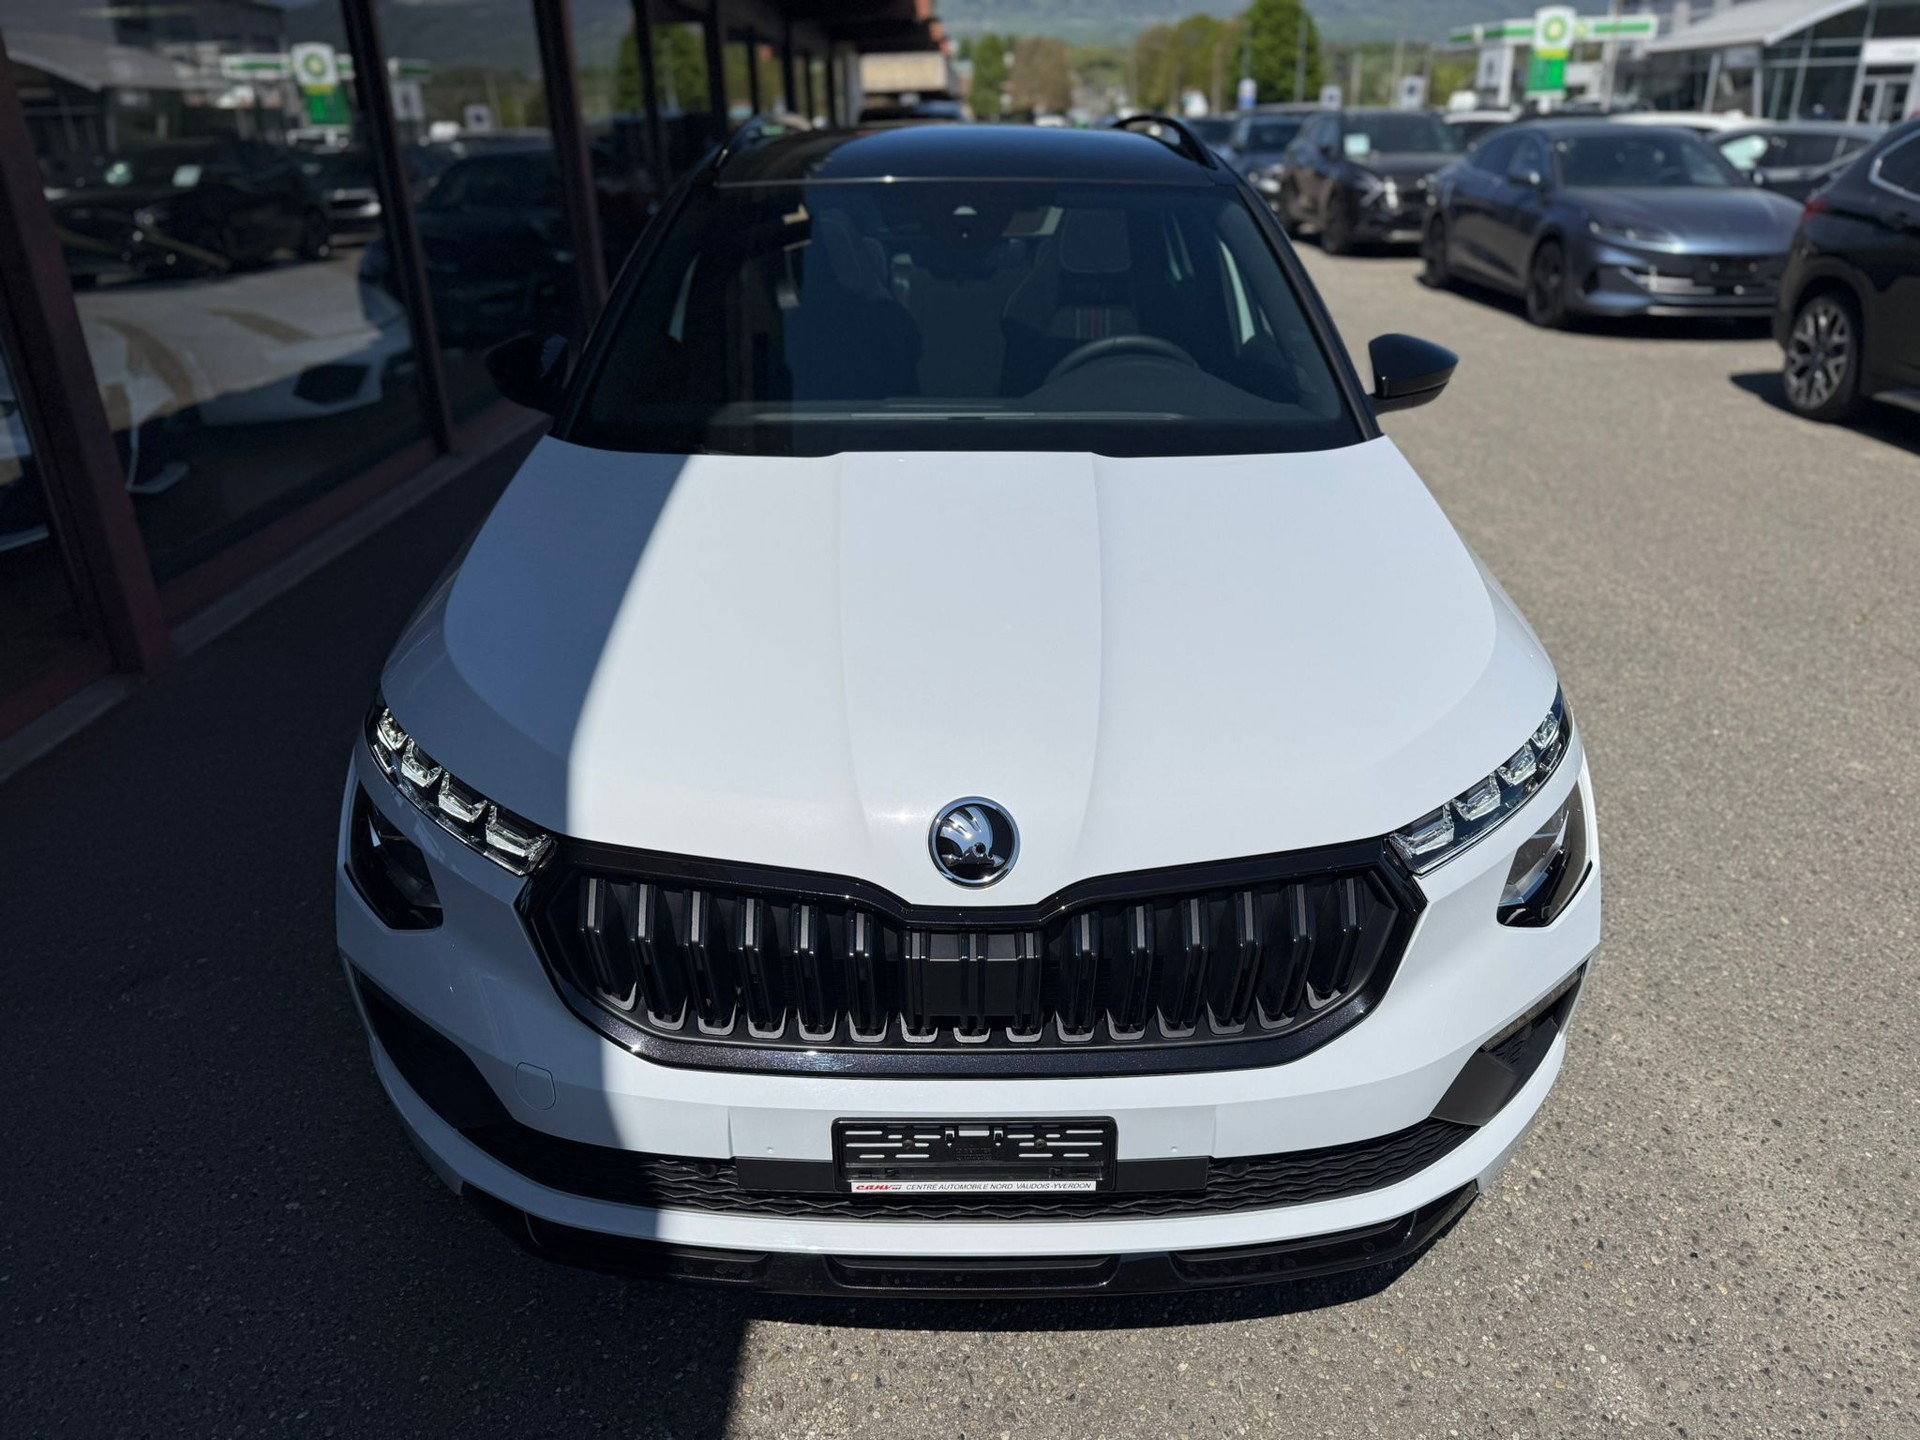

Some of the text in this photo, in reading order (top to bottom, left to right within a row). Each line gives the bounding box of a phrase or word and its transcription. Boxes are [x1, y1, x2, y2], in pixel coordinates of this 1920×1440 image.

[906, 1183, 937, 1191] CENTRE
[938, 1183, 988, 1191] AUTOMOBILE
[990, 1182, 1013, 1190] NORD
